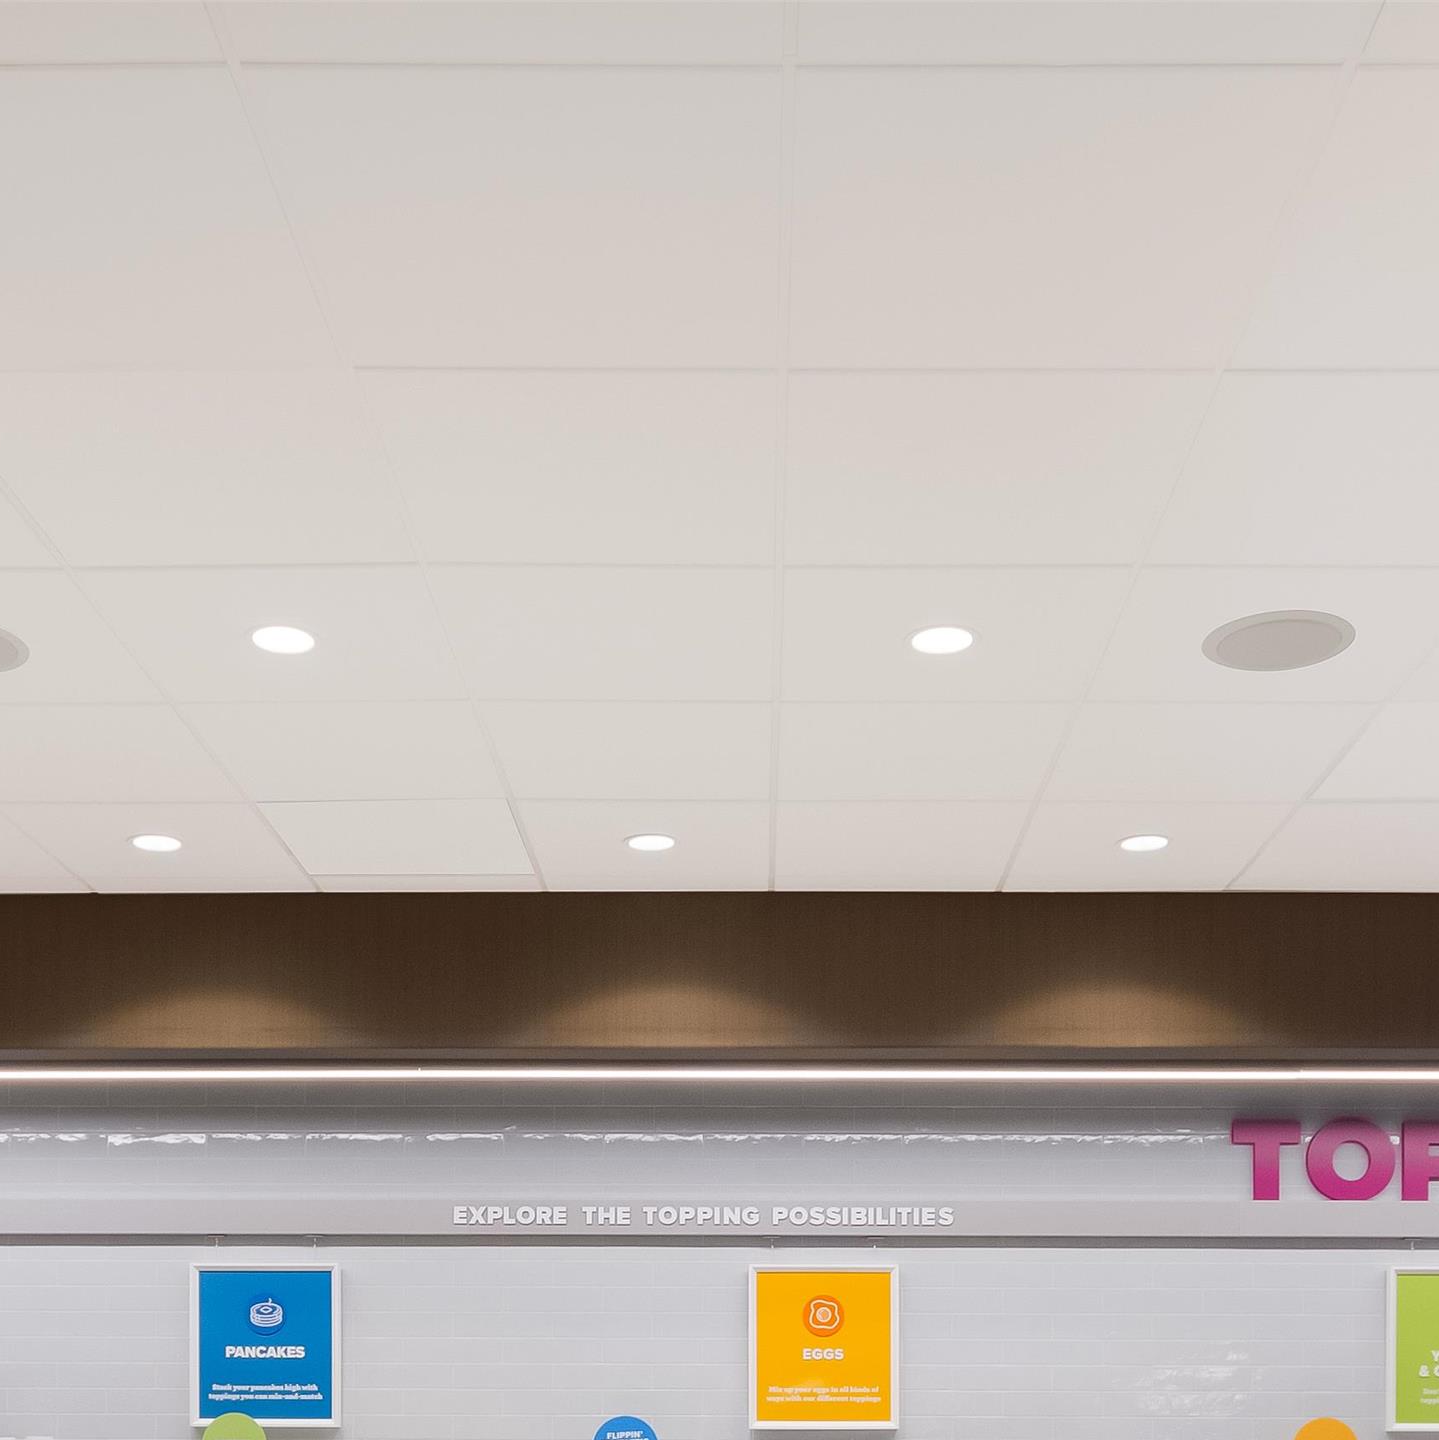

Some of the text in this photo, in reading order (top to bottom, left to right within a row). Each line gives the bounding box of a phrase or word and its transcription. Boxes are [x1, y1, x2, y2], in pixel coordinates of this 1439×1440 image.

[453, 1206, 954, 1226] EXPLORE THE TOPPING POSSIBILITIES
[225, 1345, 306, 1359] PANCAKES
[802, 1348, 845, 1360] EGGS
[1419, 1365, 1430, 1377] &
[284, 1384, 301, 1392] high
[607, 1430, 643, 1439] FLIPPIN'
